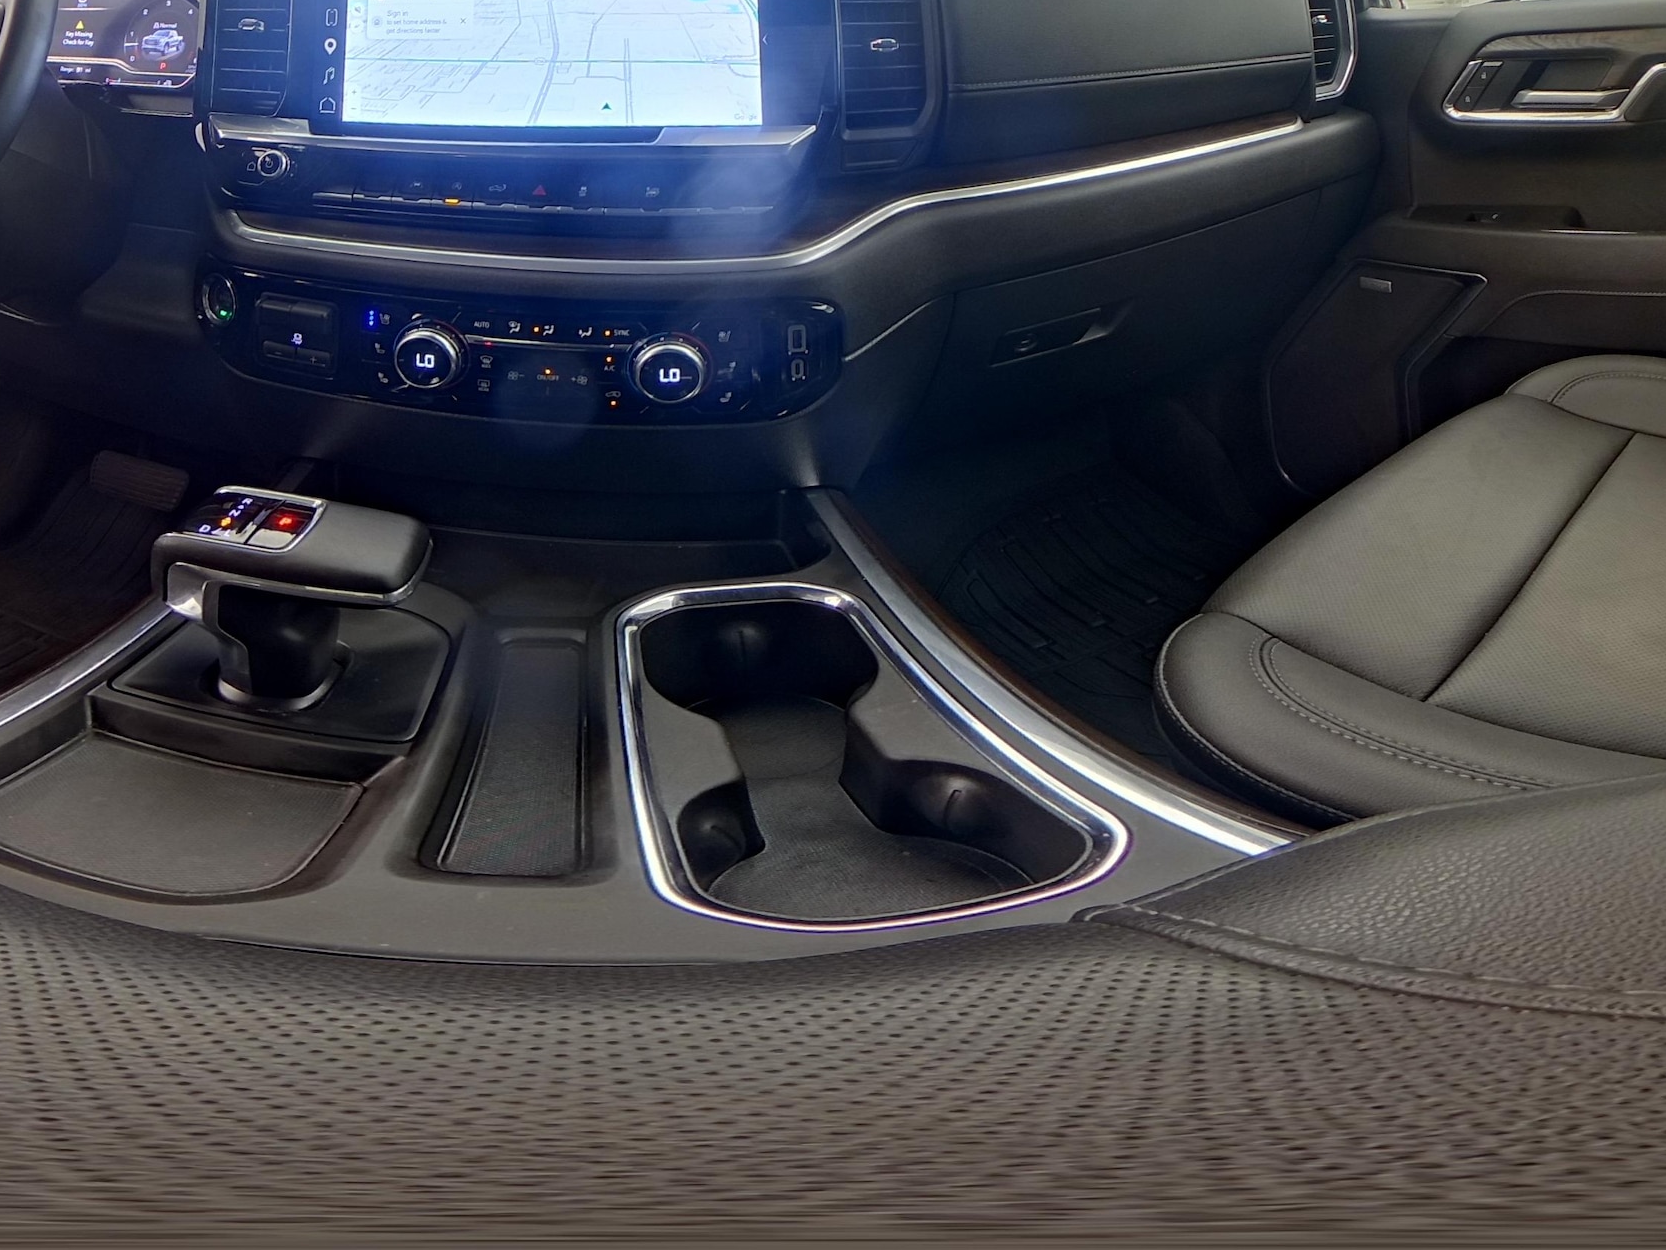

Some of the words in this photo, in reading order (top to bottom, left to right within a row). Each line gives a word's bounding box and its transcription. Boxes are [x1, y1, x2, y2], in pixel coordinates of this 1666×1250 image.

[386, 10, 401, 18] Sign
[75, 31, 93, 39] Missing
[85, 39, 94, 47] Key
[734, 113, 757, 121] Gogle
[229, 509, 241, 517] N
[279, 517, 292, 525] P
